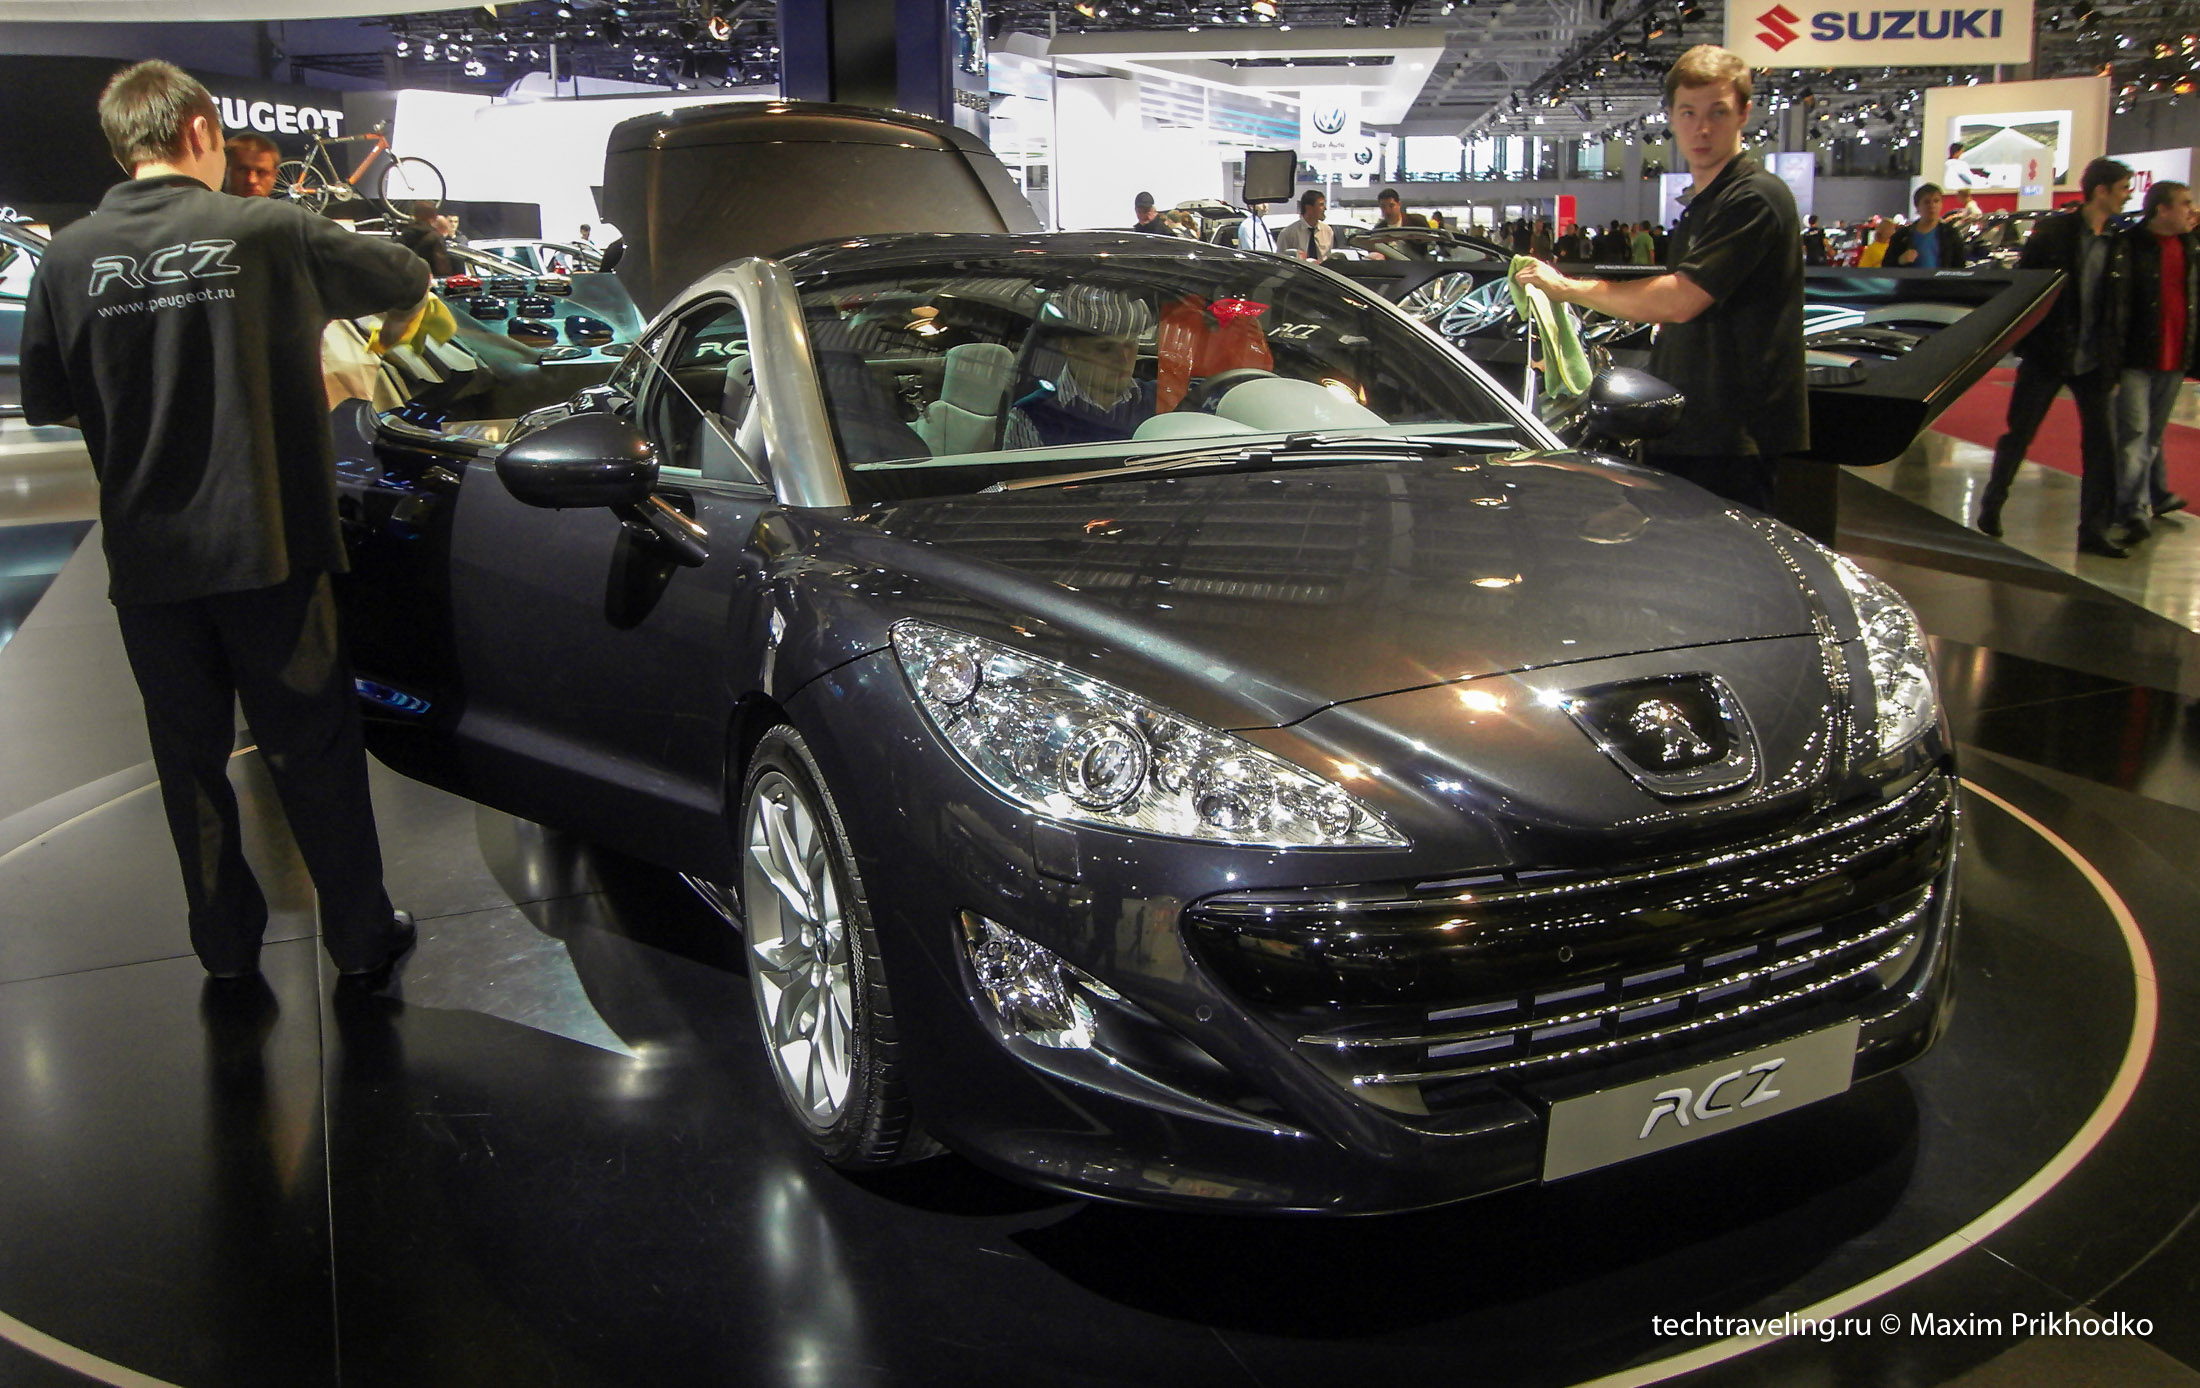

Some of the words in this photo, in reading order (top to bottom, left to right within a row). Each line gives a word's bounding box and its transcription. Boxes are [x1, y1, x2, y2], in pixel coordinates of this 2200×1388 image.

[1811, 8, 2003, 41] SUZUKI
[211, 96, 344, 138] UGEOT
[88, 239, 241, 297] RCZ
[97, 287, 236, 319] www.peugeot.ru
[1638, 1057, 1786, 1140] RCZ
